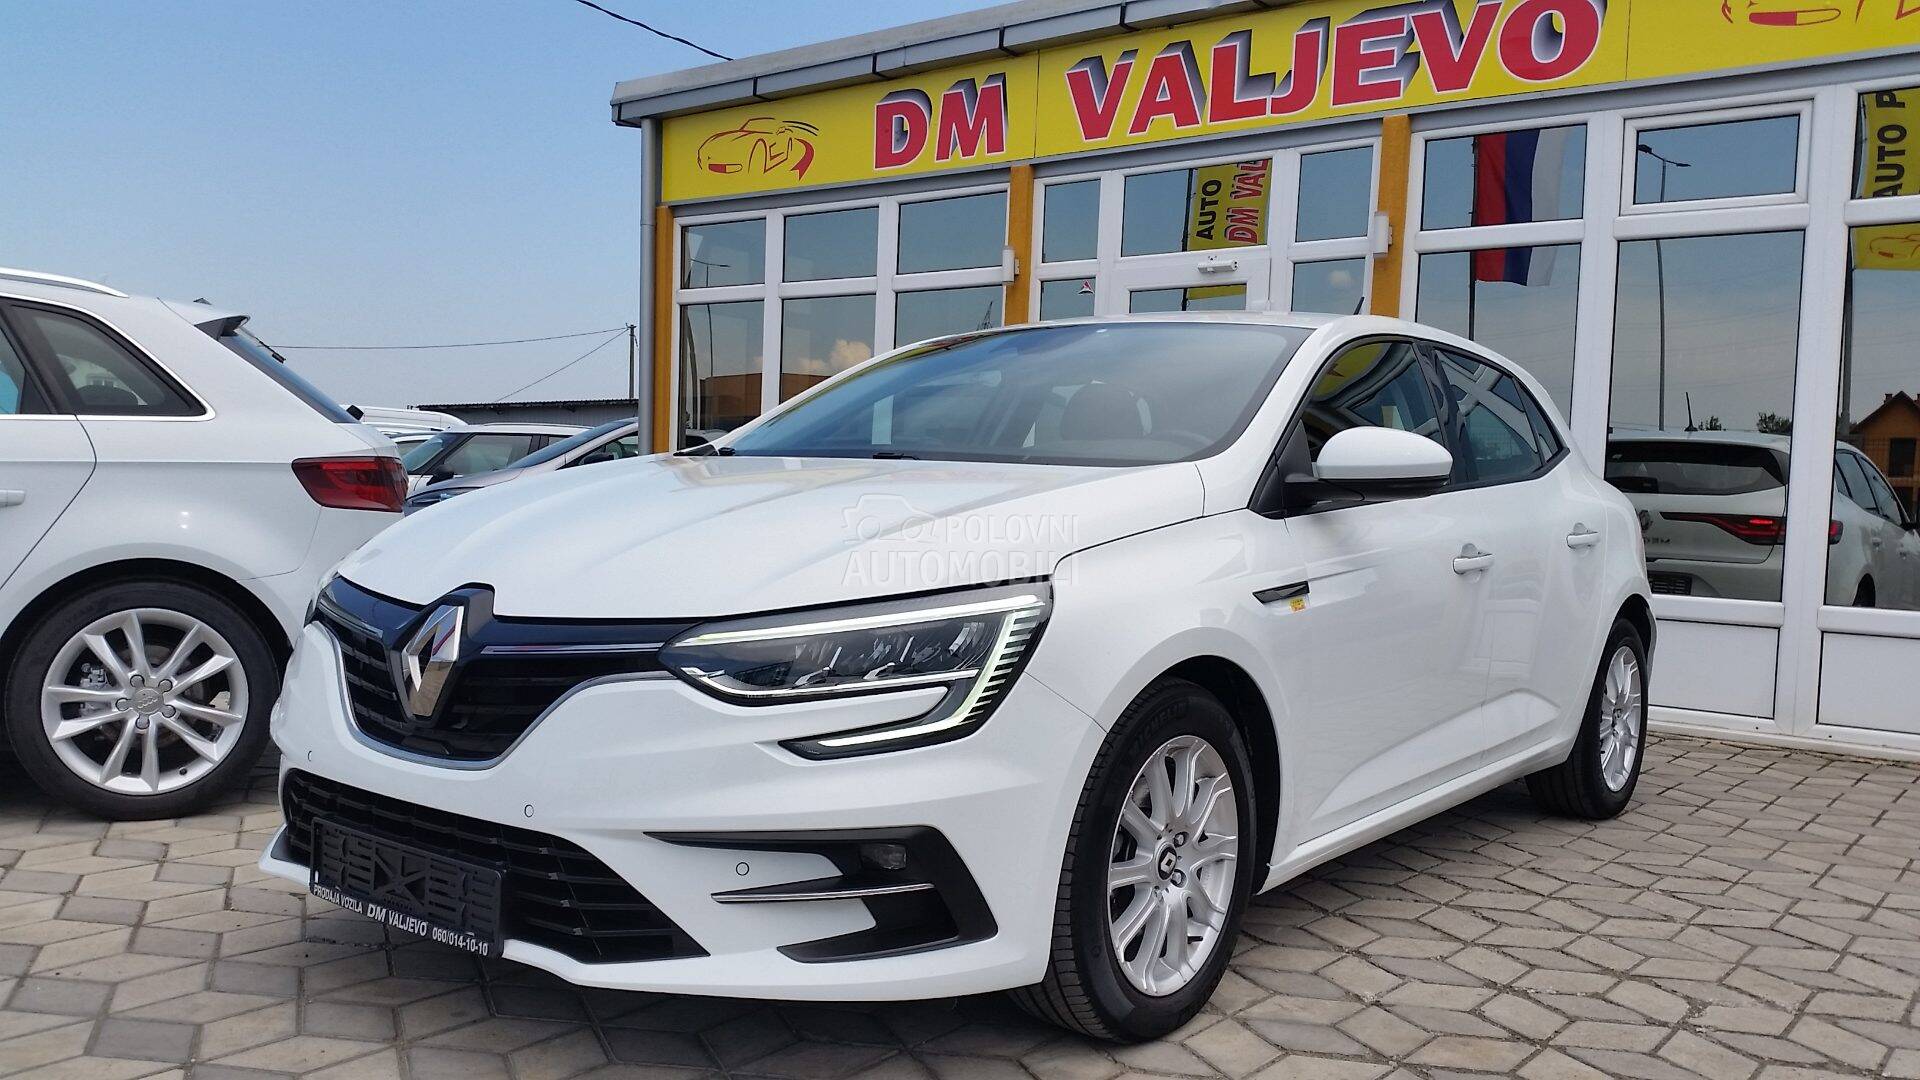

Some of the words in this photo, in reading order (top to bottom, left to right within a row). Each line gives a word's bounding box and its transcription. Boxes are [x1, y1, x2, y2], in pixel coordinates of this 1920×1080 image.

[874, 73, 1008, 171] DM
[1065, 0, 1607, 141] VALJEVO
[1873, 124, 1907, 198] AUTO
[1196, 179, 1222, 240] AUTO
[1224, 207, 1259, 245] DM
[313, 884, 340, 905] PRODAJA
[340, 894, 363, 914] VOZILA
[367, 903, 387, 923] DM
[388, 909, 428, 937] VALJEVO
[432, 926, 489, 956] 060/014-10-10
